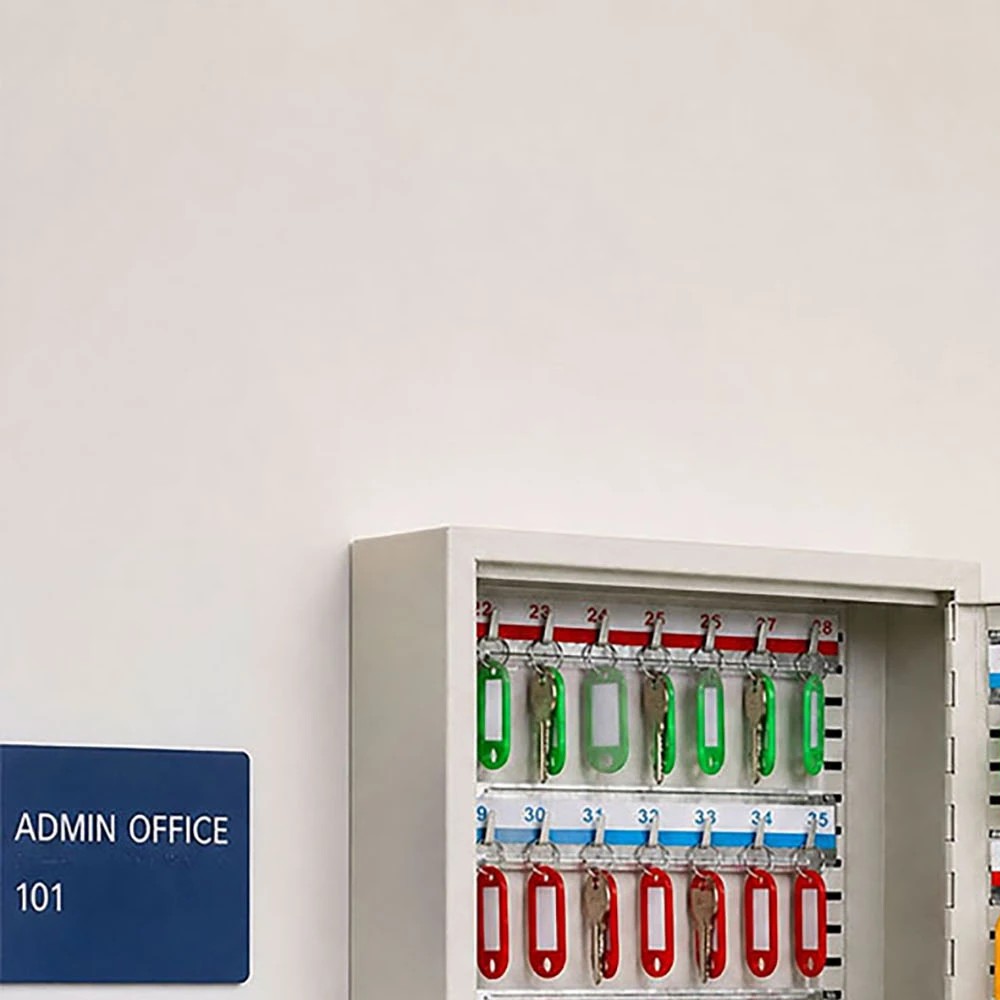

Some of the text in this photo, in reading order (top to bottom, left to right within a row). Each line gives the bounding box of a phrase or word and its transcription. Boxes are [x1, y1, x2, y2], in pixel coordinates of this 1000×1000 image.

[14, 812, 229, 845] ADMIN OFFICE
[524, 807, 546, 823] 30
[16, 881, 62, 912] 101
